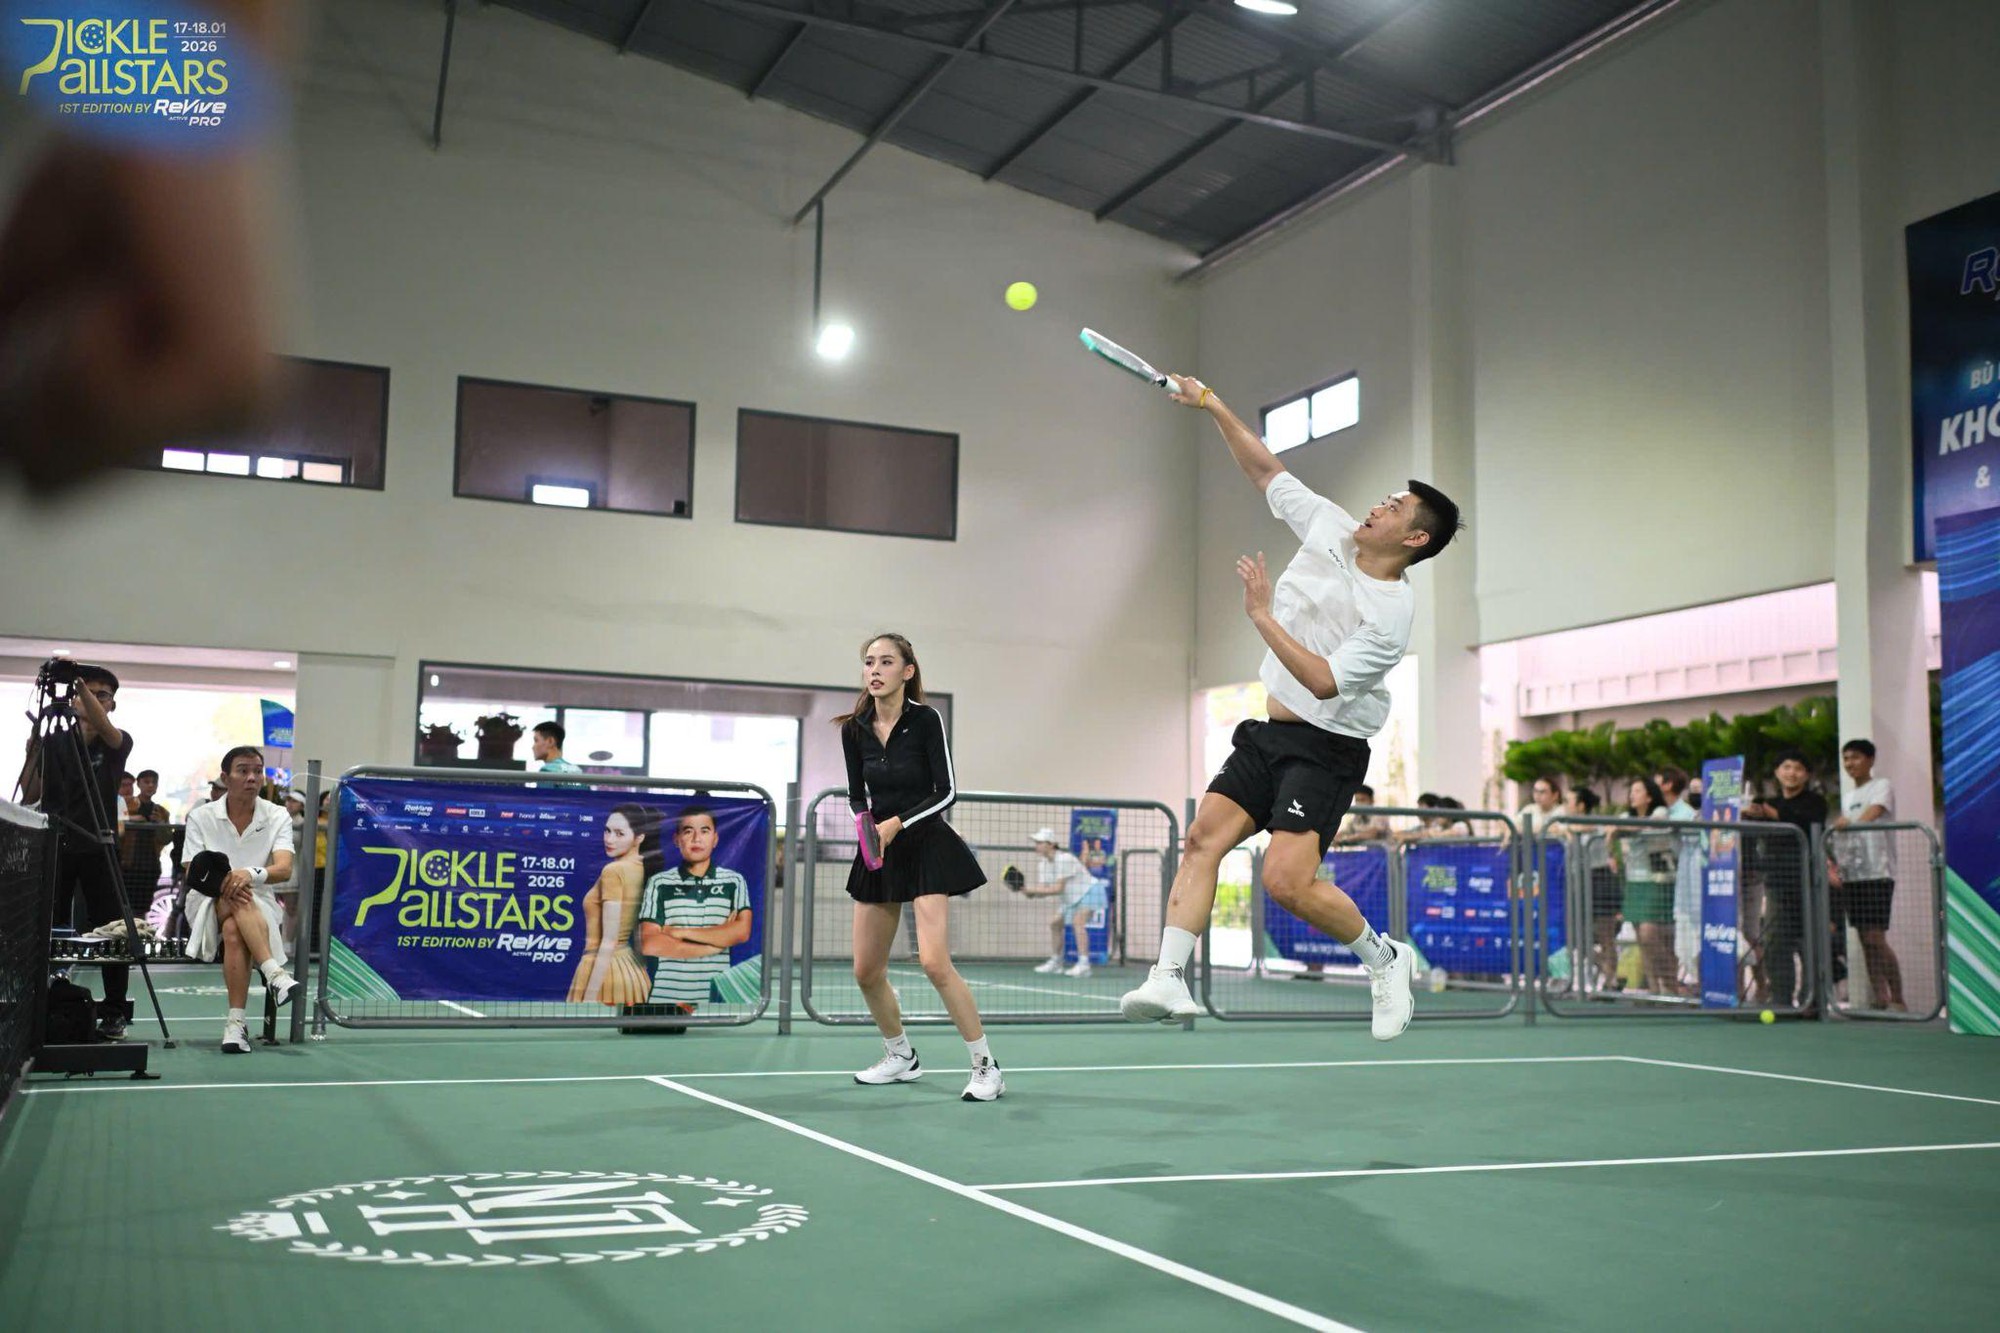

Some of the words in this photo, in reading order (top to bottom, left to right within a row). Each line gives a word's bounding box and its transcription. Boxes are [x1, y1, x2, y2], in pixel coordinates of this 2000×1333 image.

[521, 856, 575, 870] 17-18.01
[528, 875, 565, 888] 2026
[397, 936, 420, 948] 1ST
[421, 936, 477, 948] EDITION
[477, 936, 495, 949] BY
[532, 952, 565, 963] PRO
